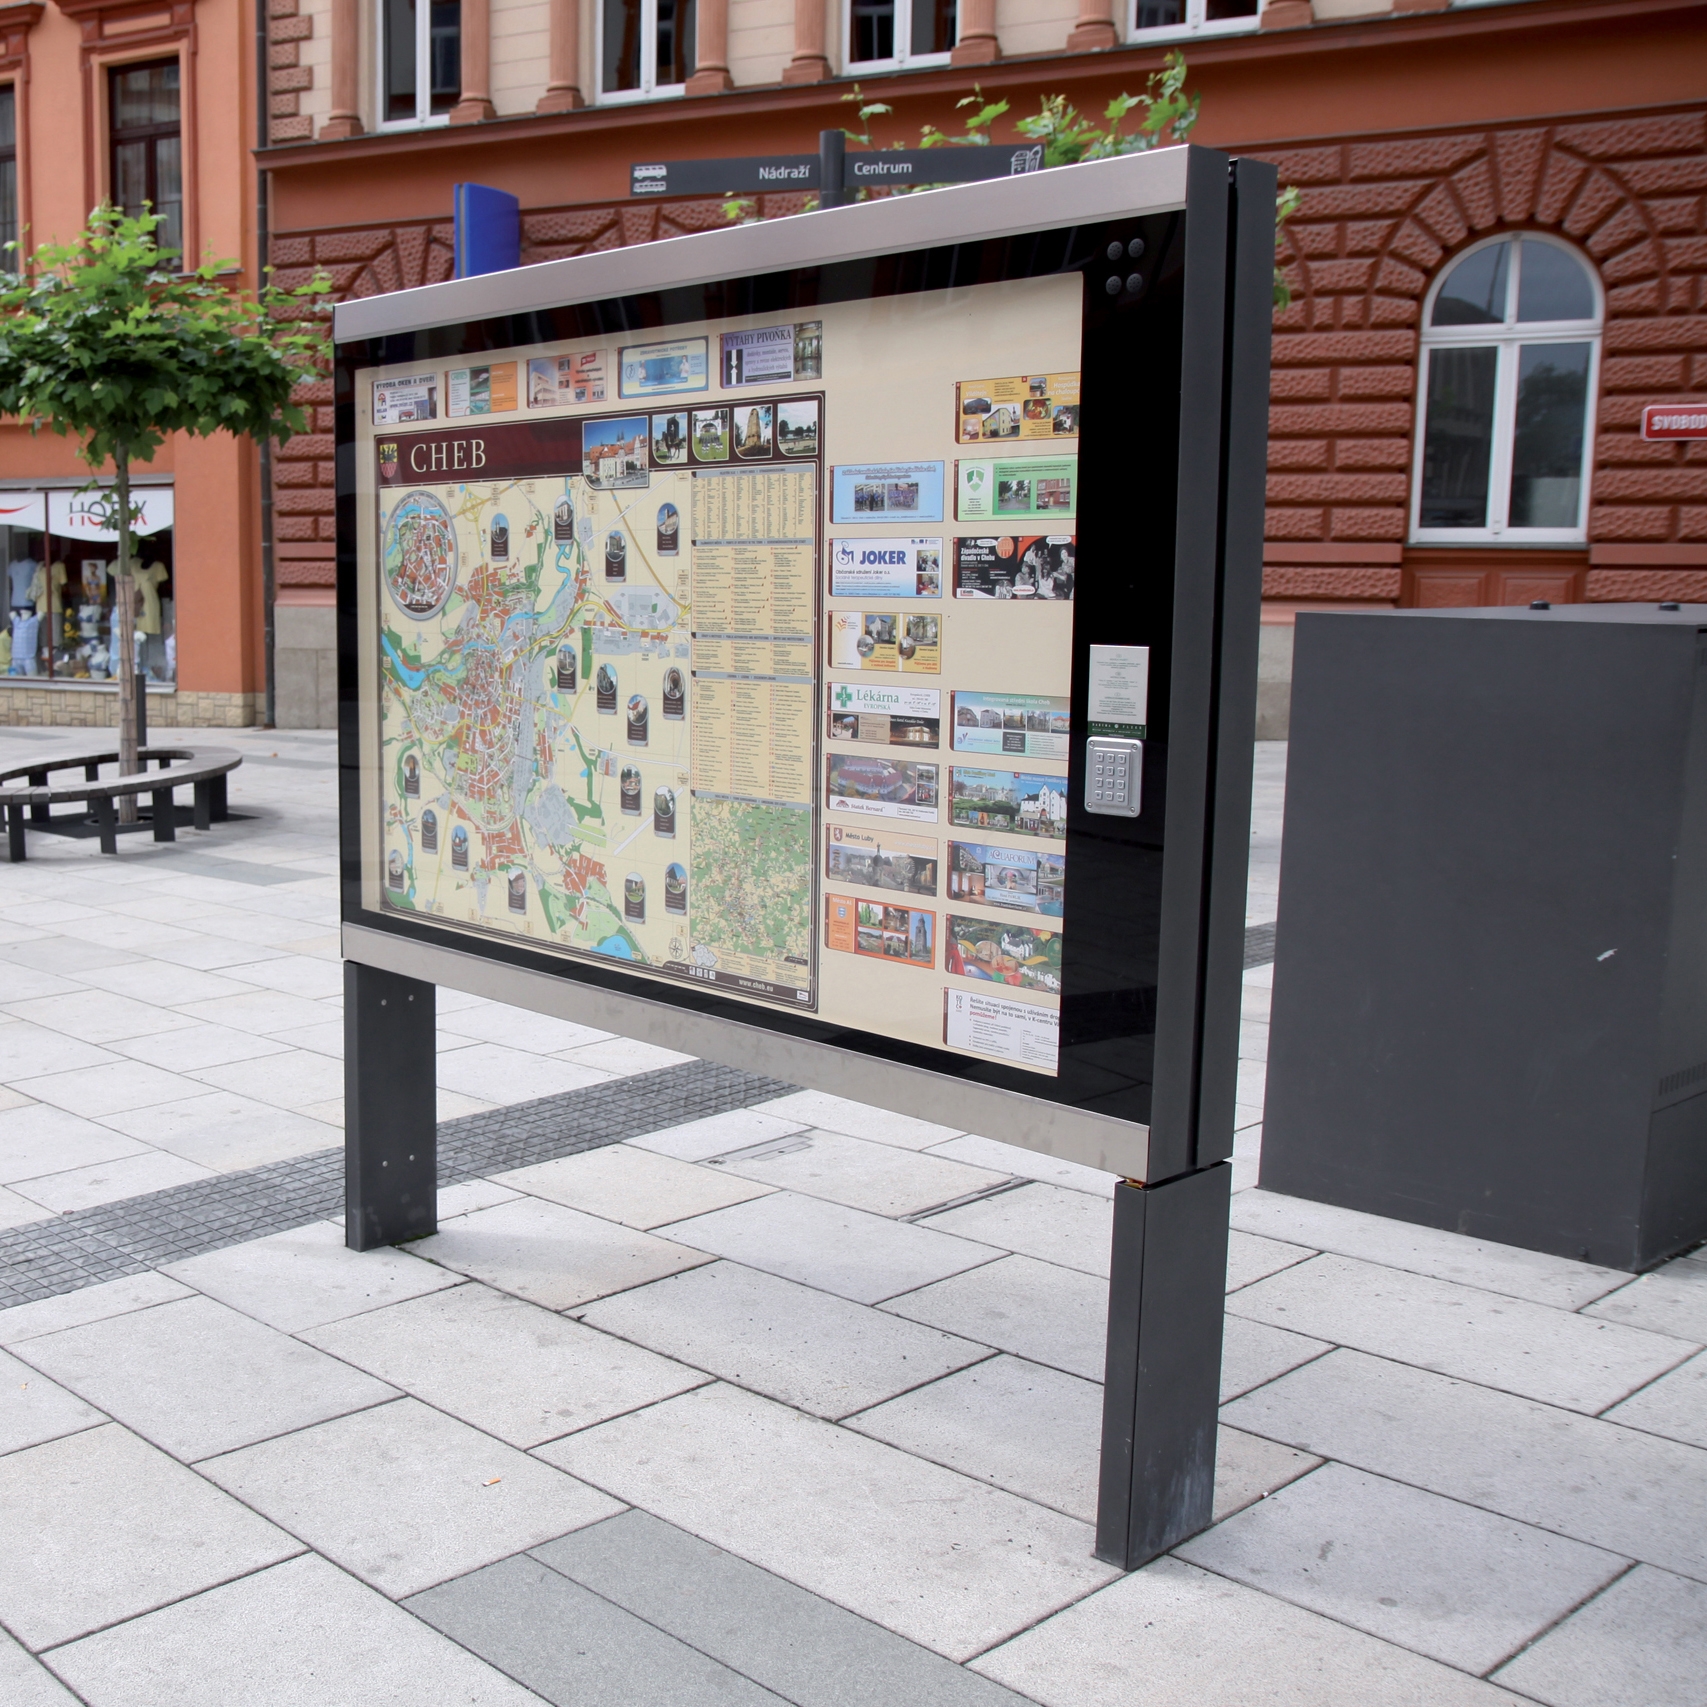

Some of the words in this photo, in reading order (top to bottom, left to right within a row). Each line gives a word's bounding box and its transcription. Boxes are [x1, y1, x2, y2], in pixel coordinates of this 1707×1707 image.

[758, 165, 810, 180] Nádraží
[854, 161, 912, 176] Centrum
[725, 334, 755, 347] VÝTAHY
[757, 328, 792, 343] PIVOŇKA
[397, 379, 412, 387] OKEN
[410, 438, 486, 473] CHEB
[859, 550, 907, 565] JOKER
[857, 689, 899, 703] Lékárna
[865, 805, 885, 813] Bernard
[845, 832, 861, 840] Město
[861, 834, 874, 842] Luby
[988, 849, 1036, 865] AQUAFORUM
[739, 978, 774, 992] www.cheb.eu
[984, 1000, 1000, 1008] situaci
[1001, 1003, 1022, 1014] spojenou
